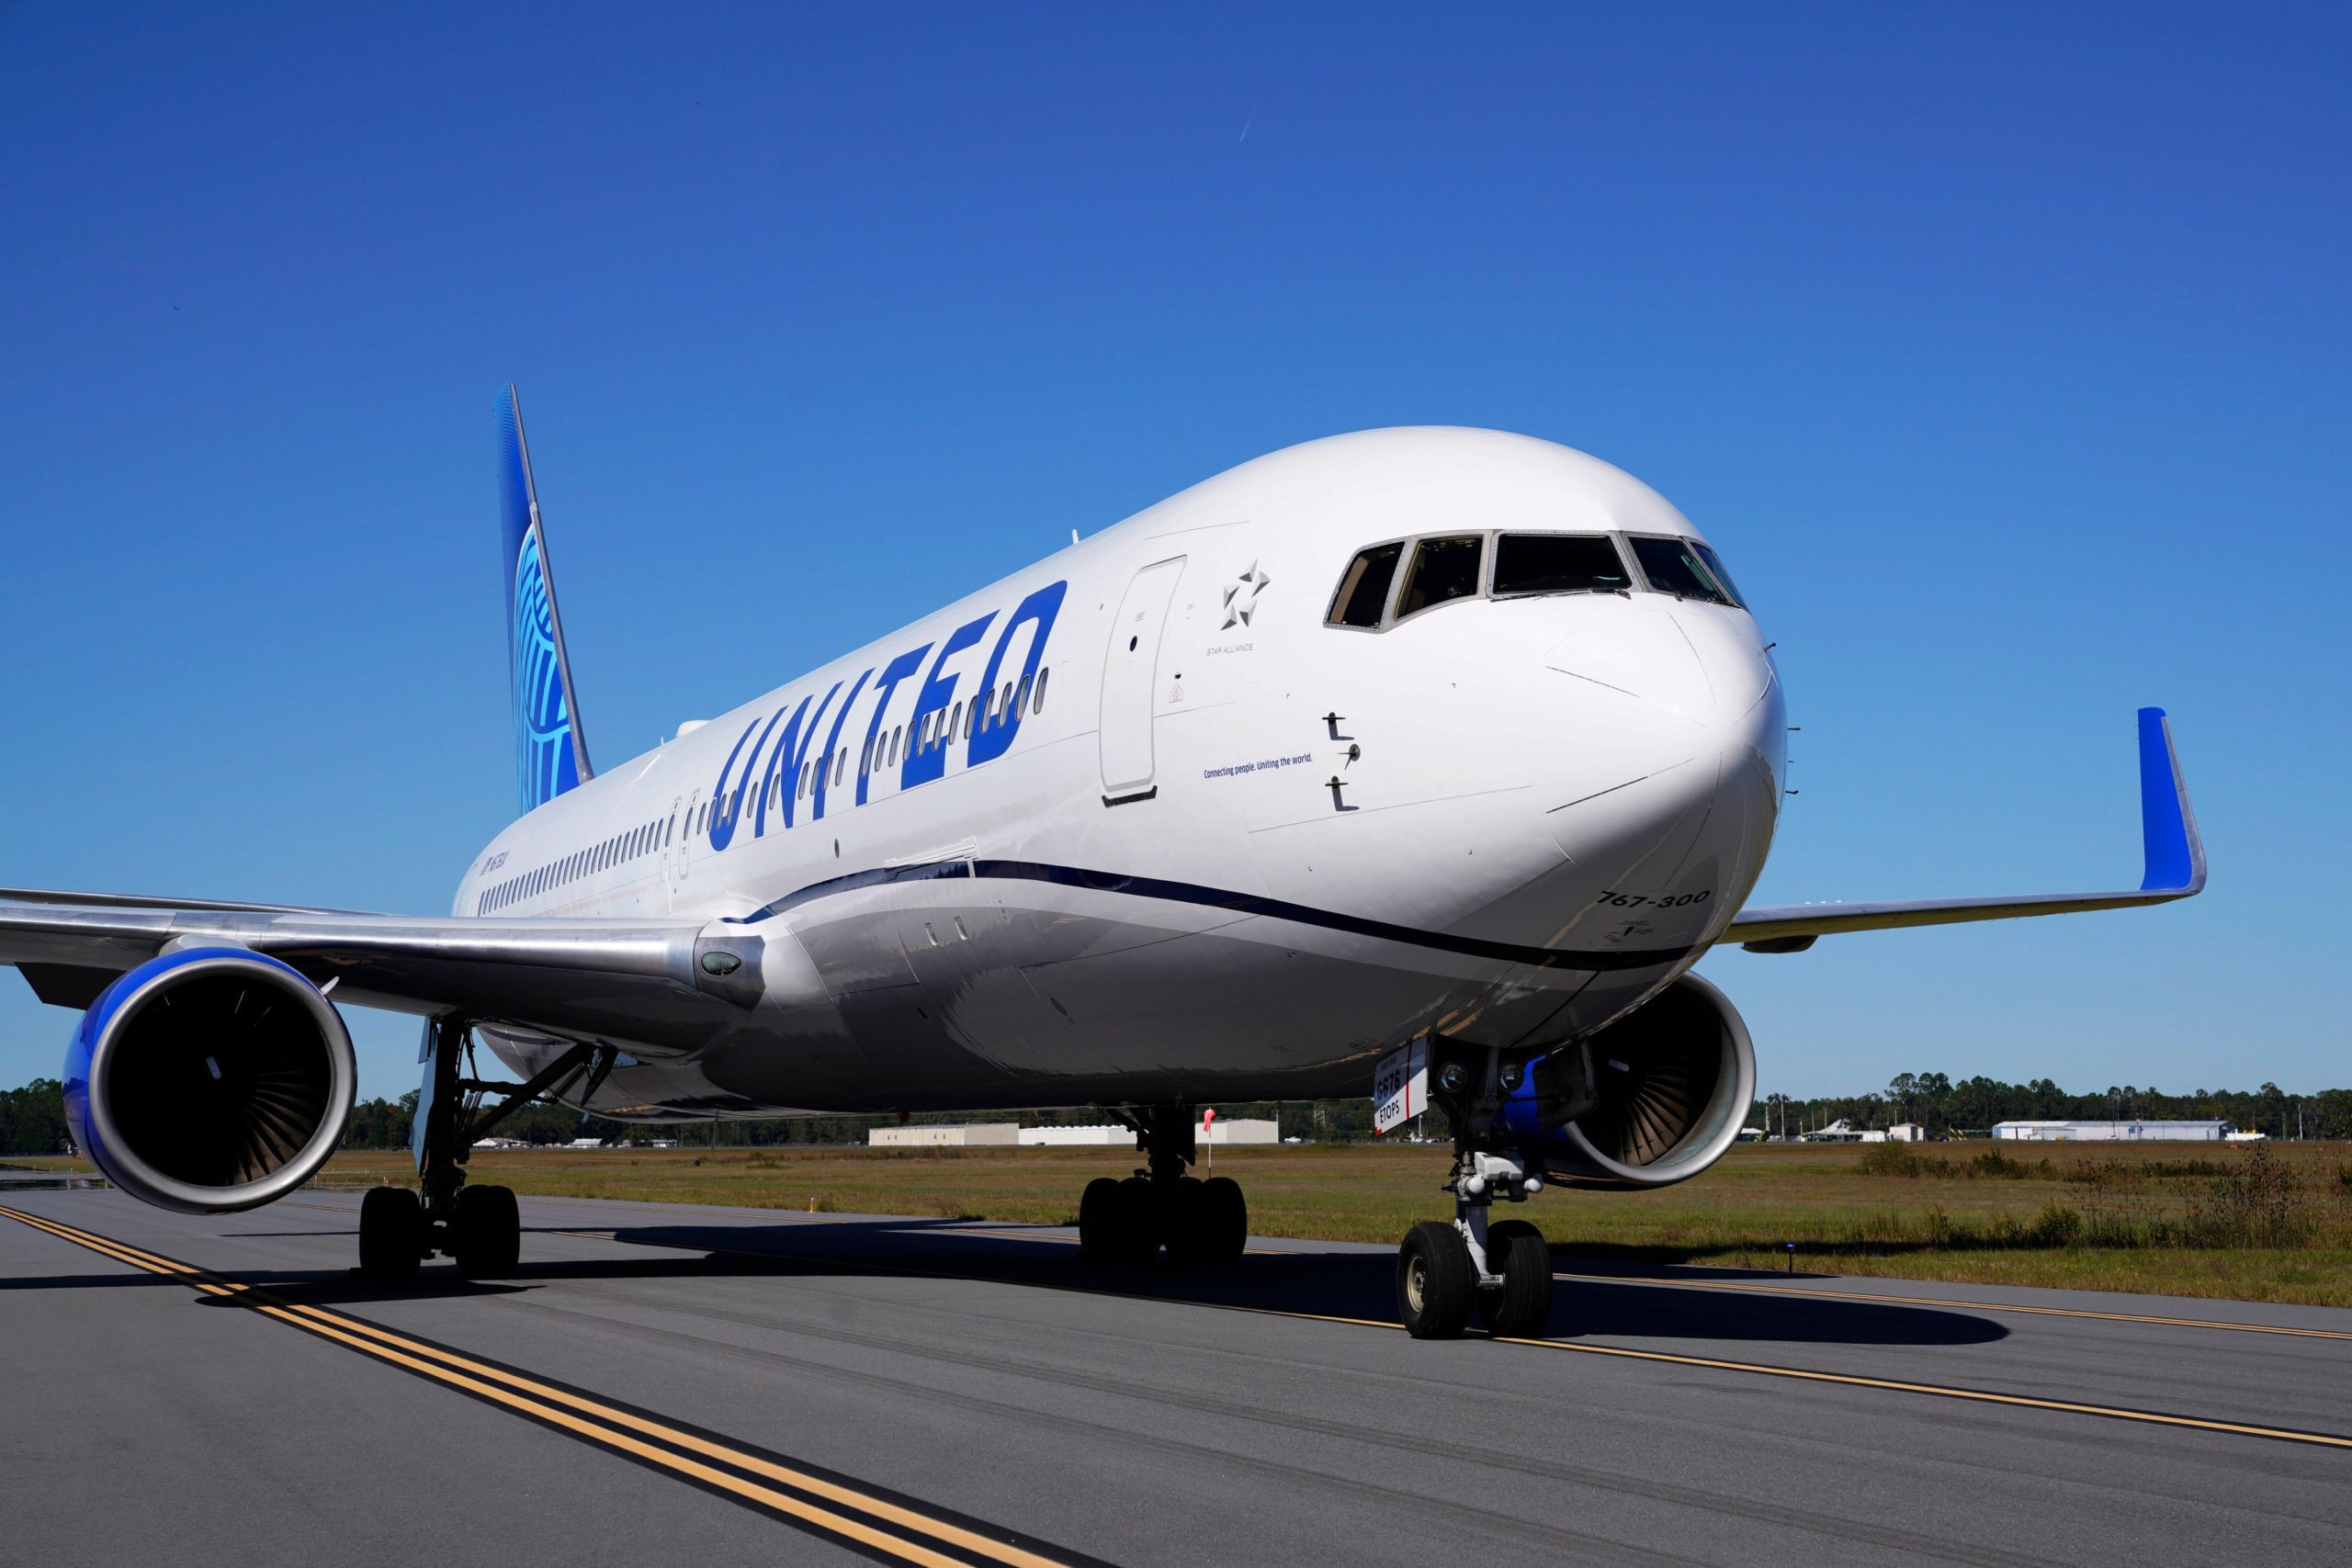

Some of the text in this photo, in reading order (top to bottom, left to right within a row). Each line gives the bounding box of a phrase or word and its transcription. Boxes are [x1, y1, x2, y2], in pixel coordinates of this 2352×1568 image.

[1206, 643, 1253, 656] STAR ALLIANCE
[708, 580, 1068, 852] UNITED
[1204, 752, 1313, 779] Connecting people. Uniting the world.
[1596, 890, 1710, 908] 767-300
[1377, 1070, 1401, 1100] 6676
[1379, 1100, 1400, 1123] ETOPS
